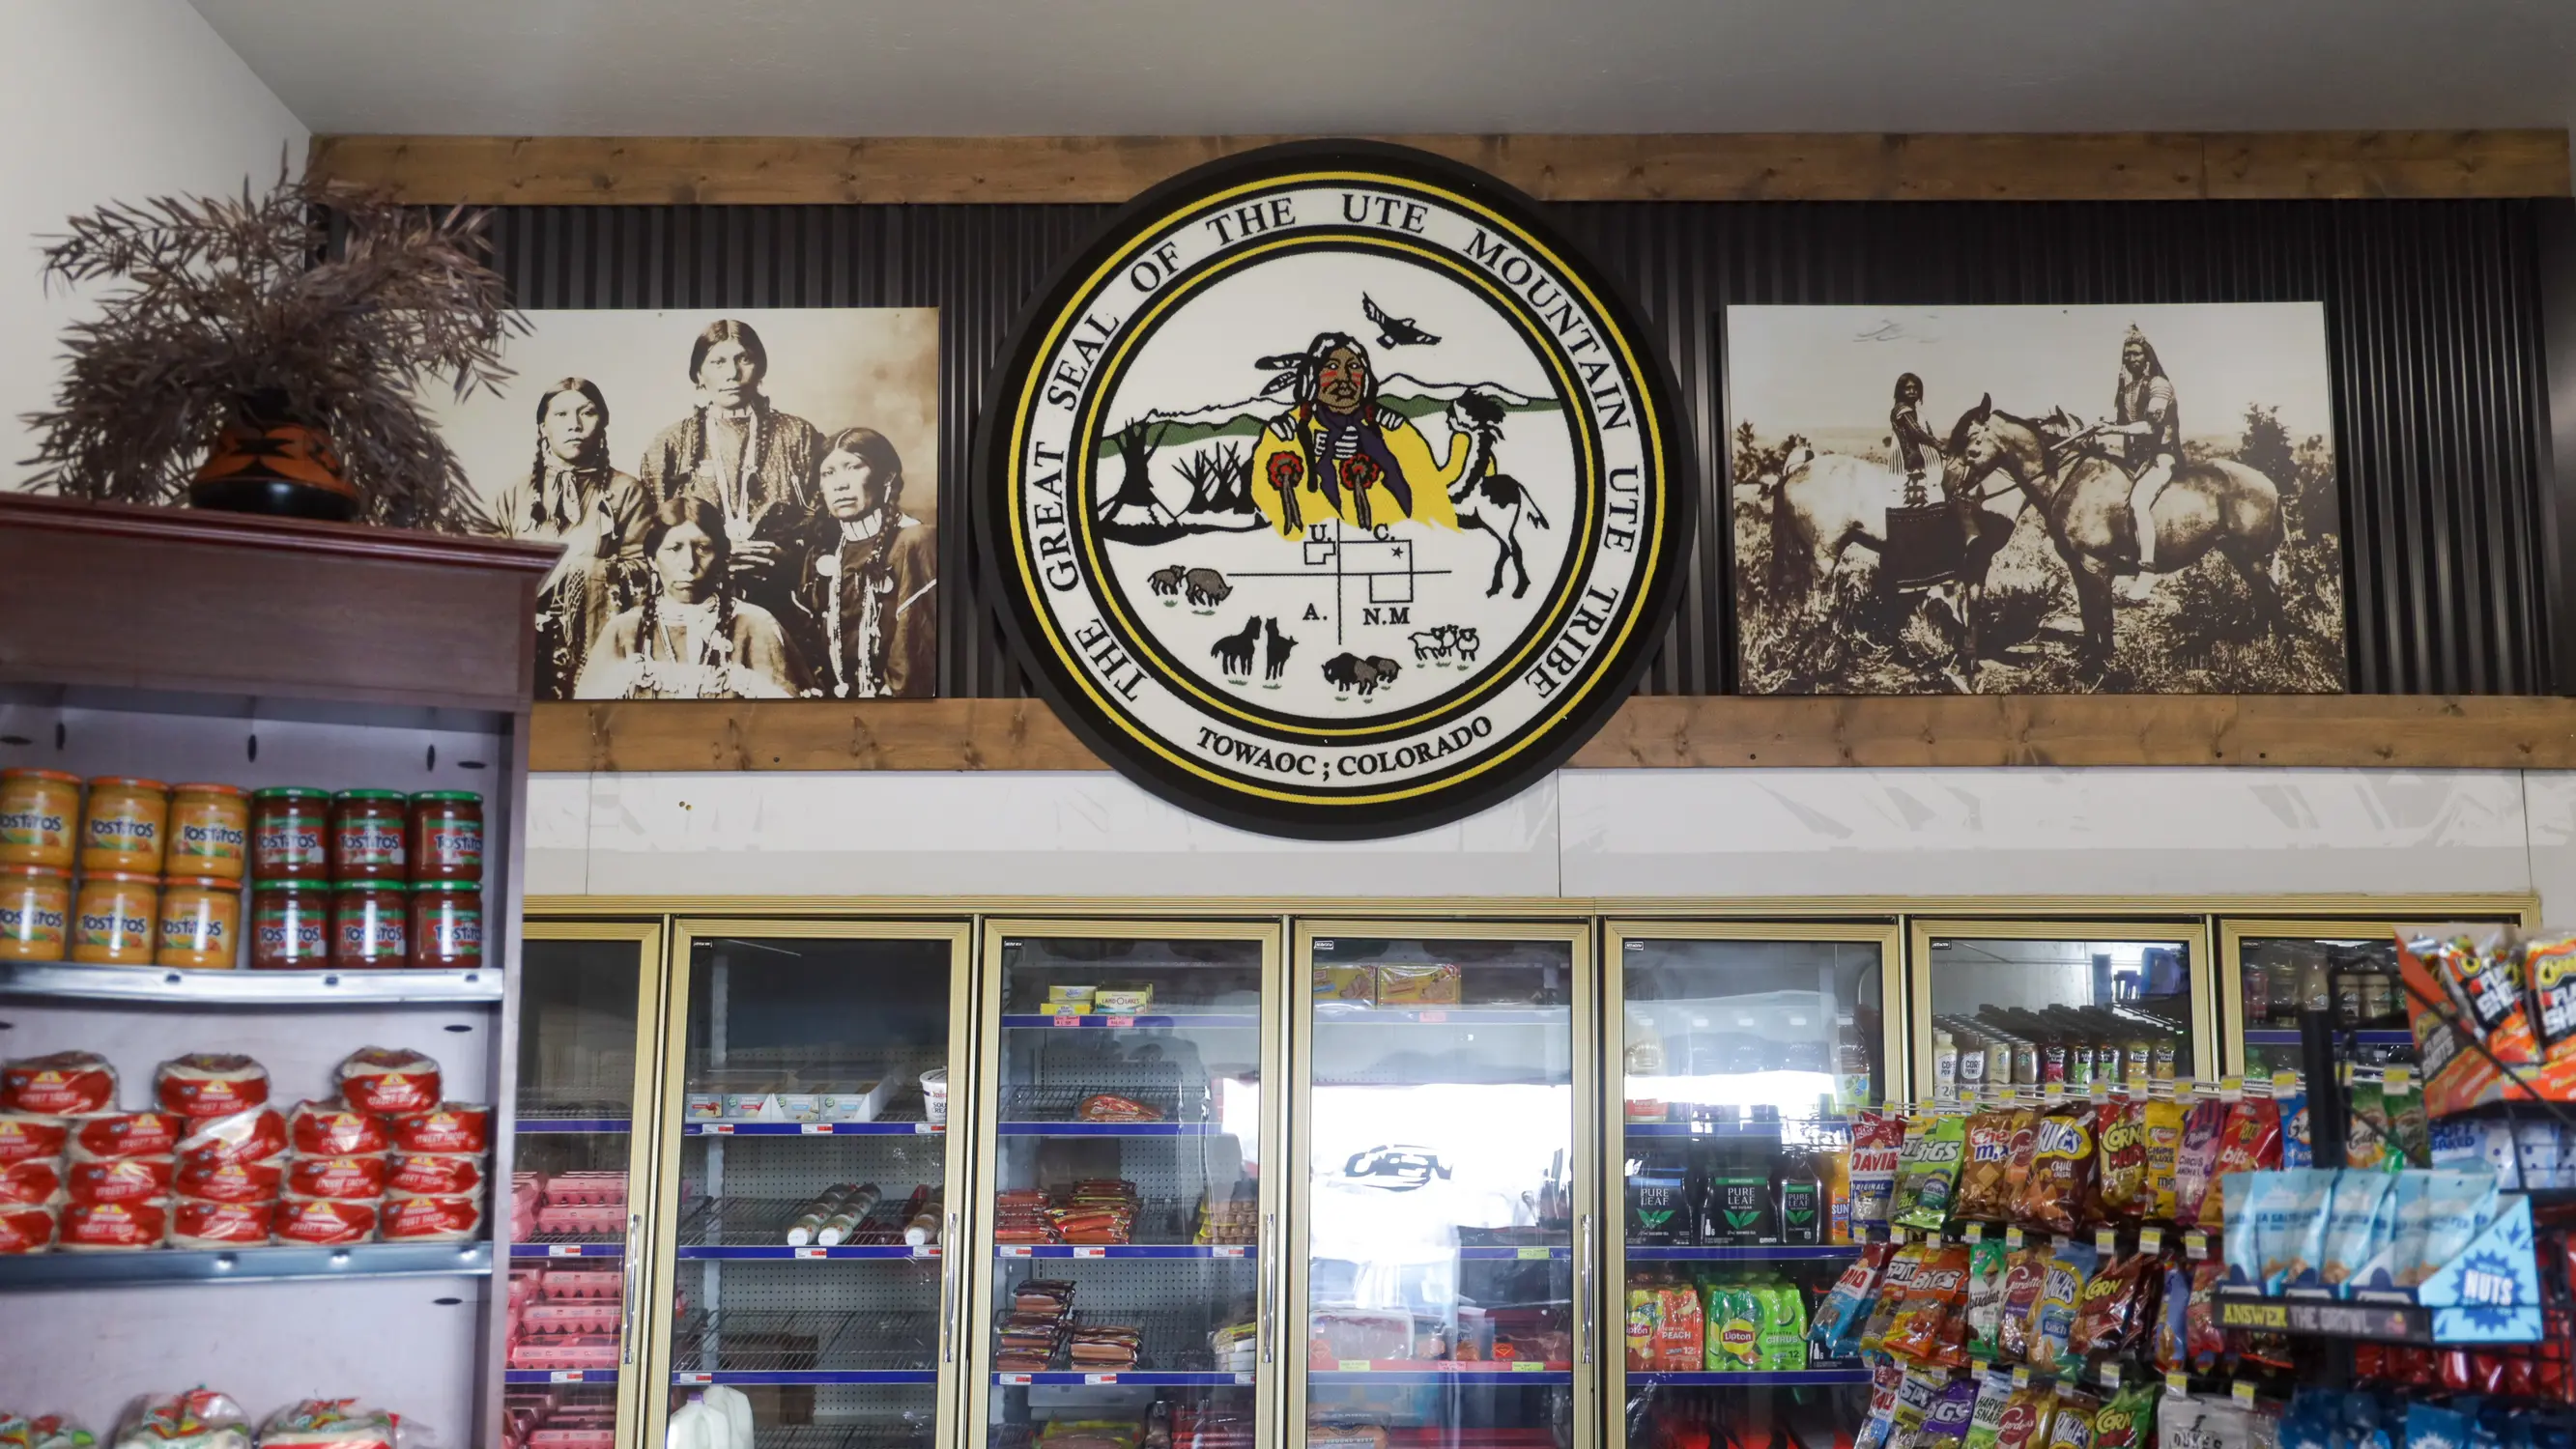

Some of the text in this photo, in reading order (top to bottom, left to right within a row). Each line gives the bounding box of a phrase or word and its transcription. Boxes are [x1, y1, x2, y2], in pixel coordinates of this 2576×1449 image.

[1033, 194, 1639, 701] THE GREAT SEAL OF THE UTE MOUNTAIN UTE TRIBE
[1337, 716, 1493, 776] COLORADO
[1971, 1127, 2010, 1147] Che
[1728, 1187, 1755, 1197] PURE
[1728, 1197, 1755, 1206] LEAF
[2465, 1268, 2513, 1305] NUTS
[1724, 1332, 1752, 1343] Lipton
